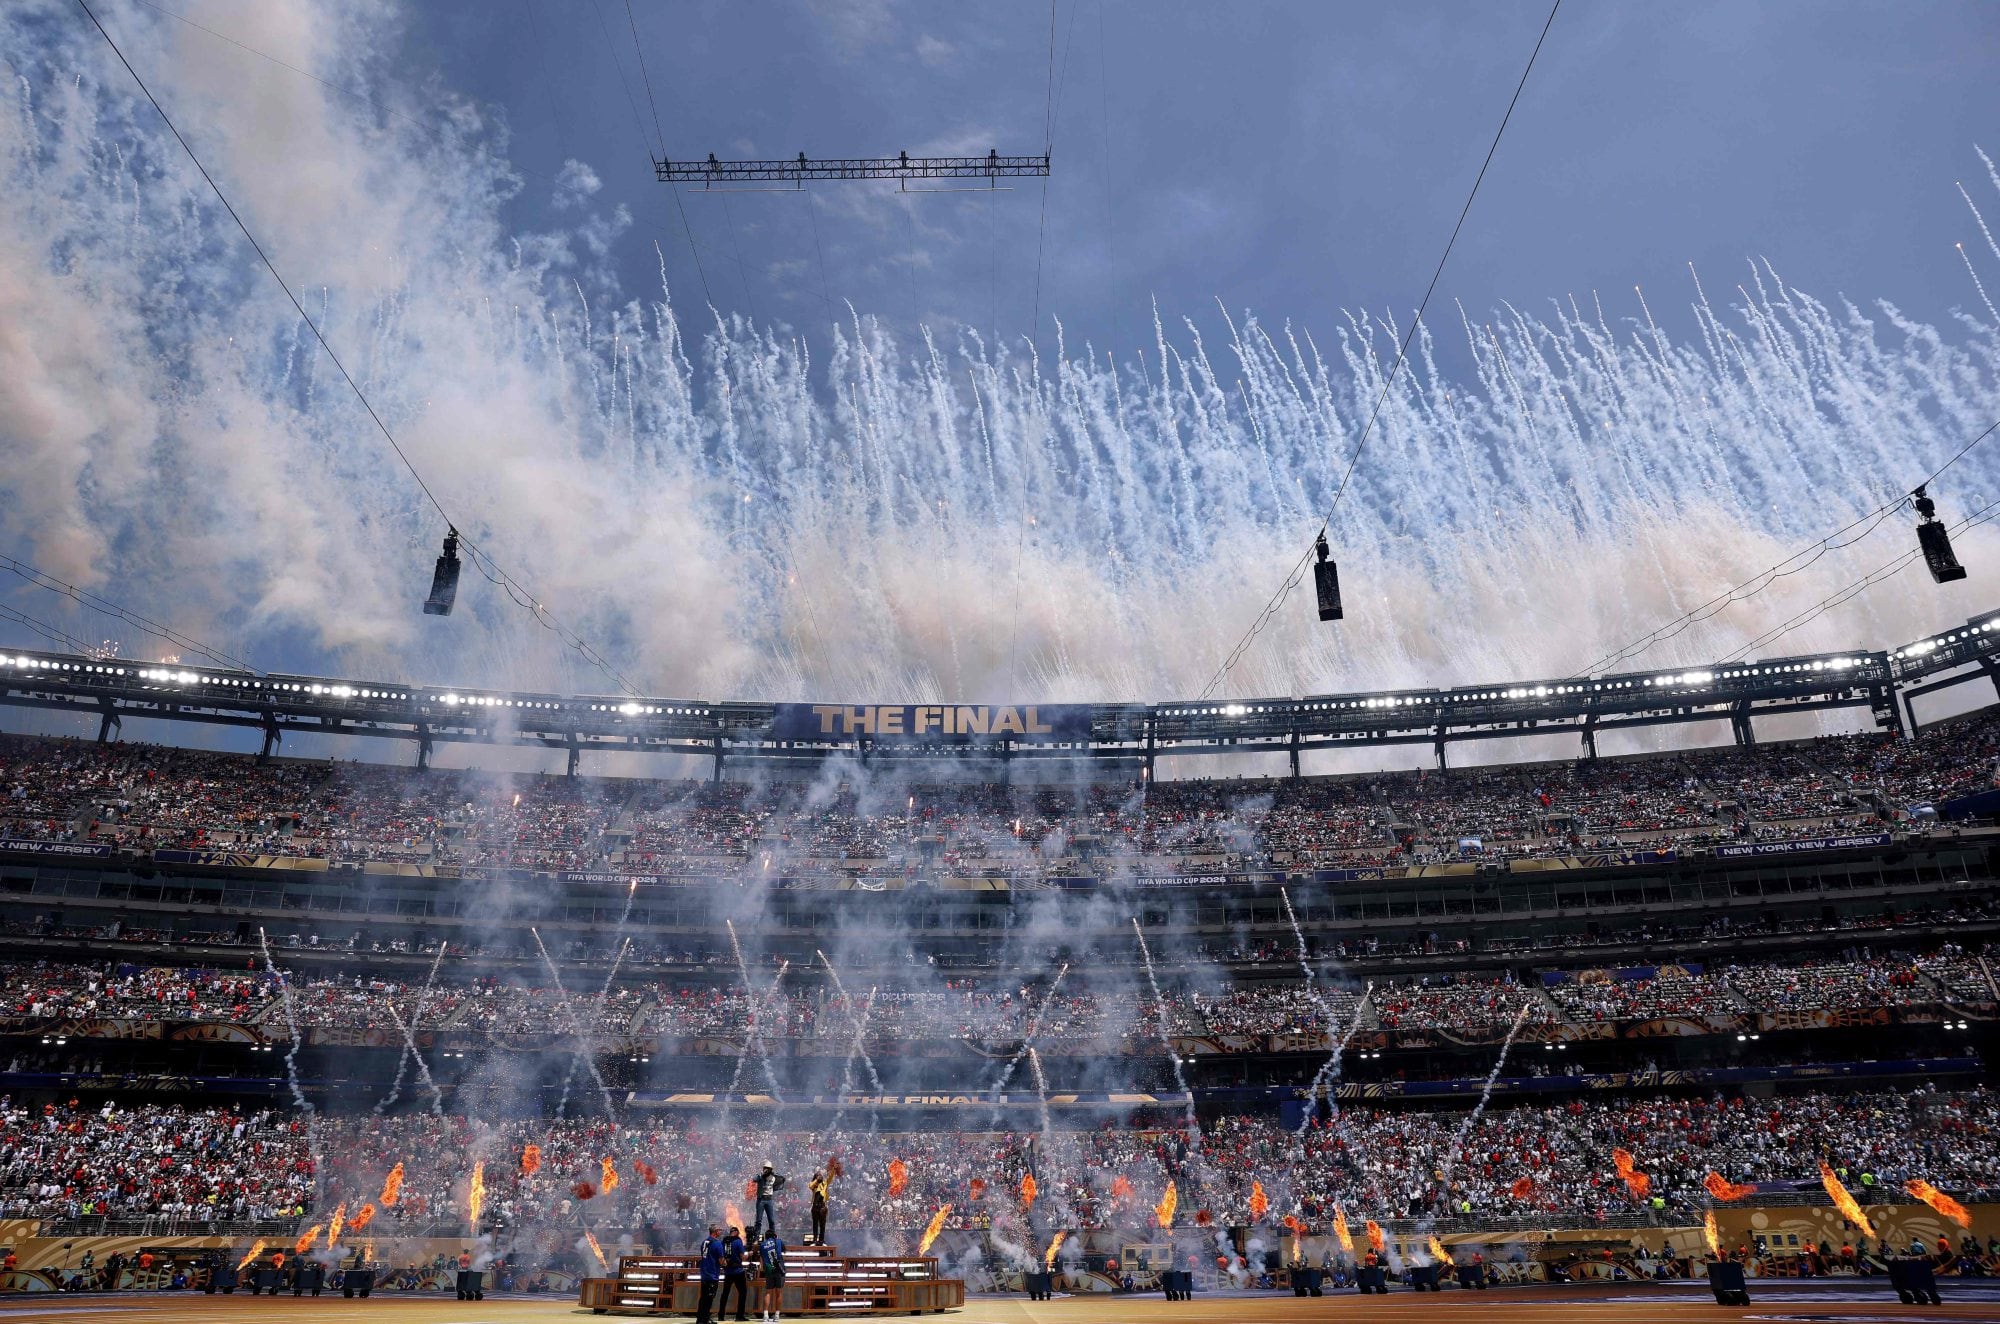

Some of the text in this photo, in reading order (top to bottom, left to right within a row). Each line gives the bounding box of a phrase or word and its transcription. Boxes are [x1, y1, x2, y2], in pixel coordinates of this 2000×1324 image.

[813, 706, 1052, 733] THE FINAL
[8, 842, 42, 851] NEW
[45, 845, 102, 854] JERSEY
[1724, 836, 1882, 855] NEW YORK NEW JERSEY
[1199, 876, 1226, 884] 2026
[1231, 875, 1247, 883] THE
[1248, 874, 1276, 882] FINAL
[848, 1096, 988, 1104] THE FINAL
